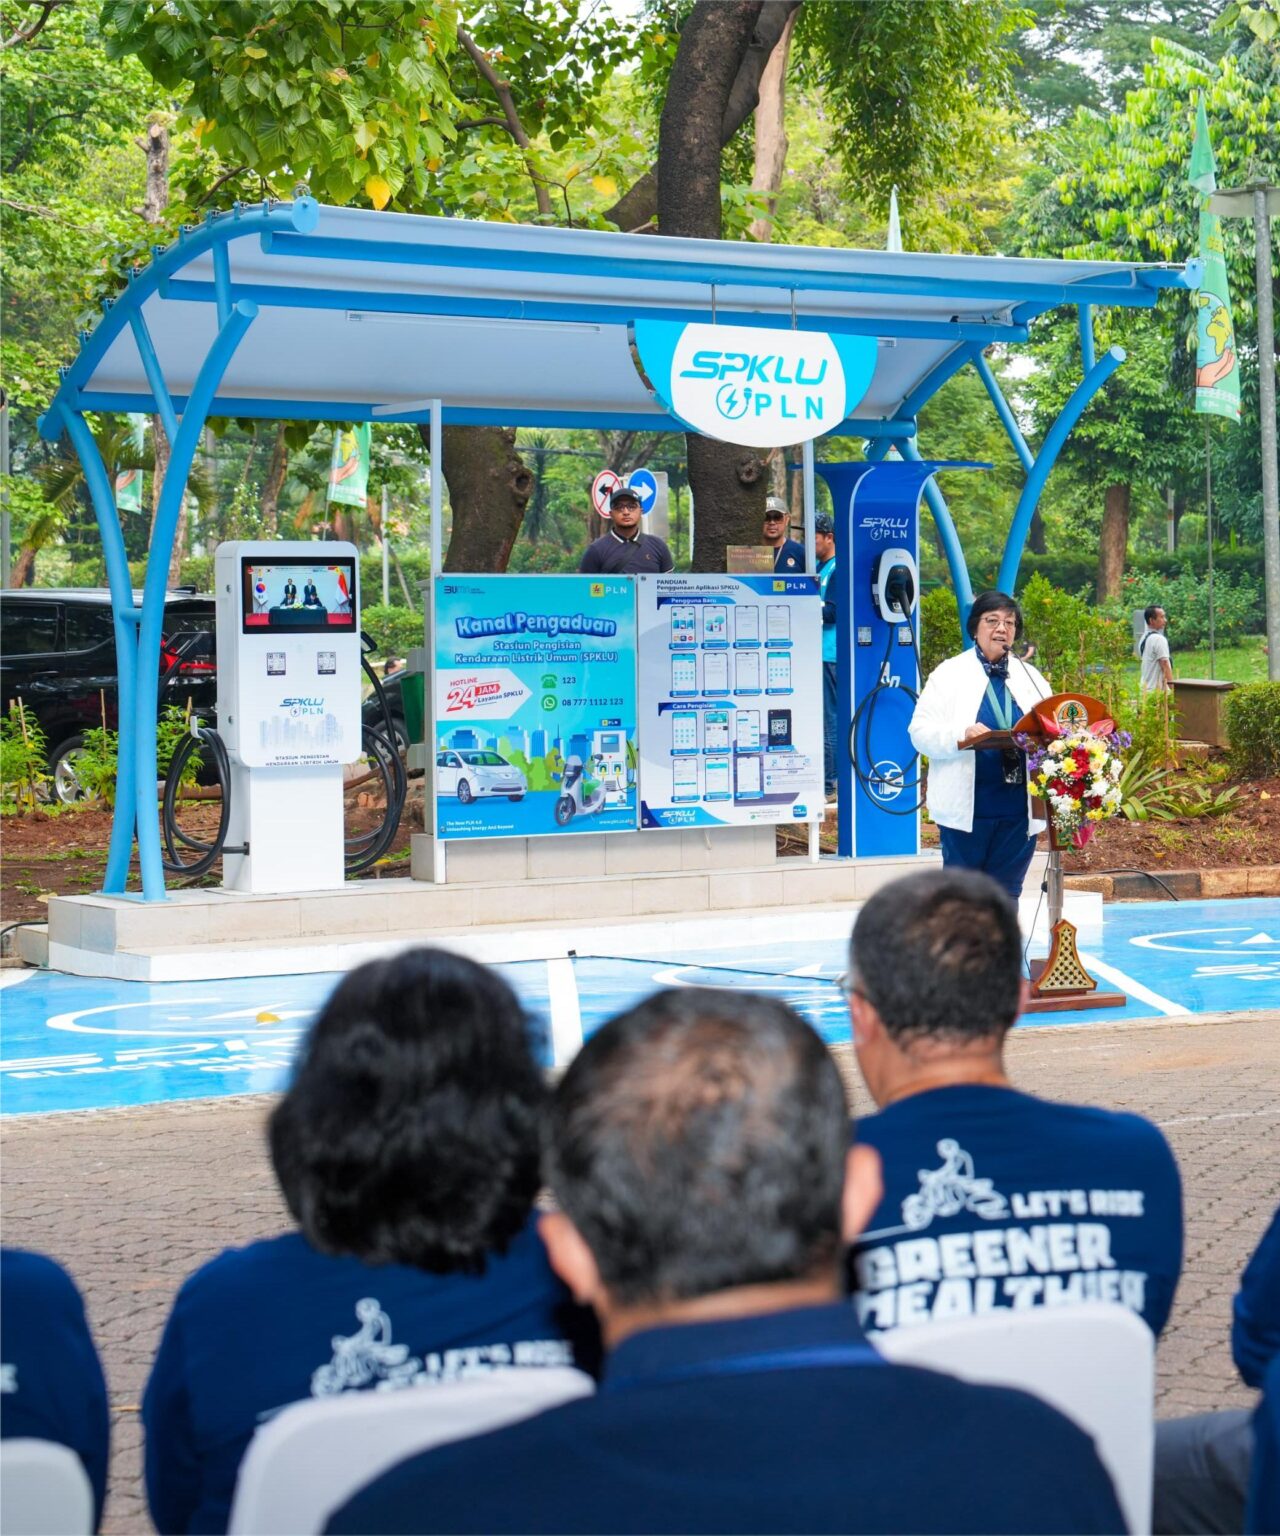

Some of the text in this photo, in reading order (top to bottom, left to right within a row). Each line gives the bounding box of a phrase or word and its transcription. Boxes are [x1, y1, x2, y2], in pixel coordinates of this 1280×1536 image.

[680, 351, 828, 386] SPKLU
[755, 393, 824, 420] PLN
[859, 517, 909, 528] SPKLU
[884, 529, 908, 539] PLN
[605, 586, 628, 594] PLN
[457, 612, 617, 636] Kanal Pengaduan
[493, 640, 581, 651] Stasiun Pengisian
[455, 652, 618, 663] Kendaraan Listrik Umum (SPKLU)
[450, 677, 478, 686] HOTLINE
[562, 676, 577, 684] 123
[446, 685, 498, 712] 24 JAM
[477, 689, 524, 703] Layanan SPKLU
[279, 697, 325, 707] SPKLU
[562, 698, 624, 706] 08 777 1112 123
[687, 702, 717, 710] Pengisian
[302, 707, 324, 715] PLN
[660, 810, 696, 818] SPKLU
[1011, 1189, 1145, 1218] LET'S RIDE
[855, 1222, 1118, 1291] GREENER
[856, 1269, 1149, 1329] HEALTHIER
